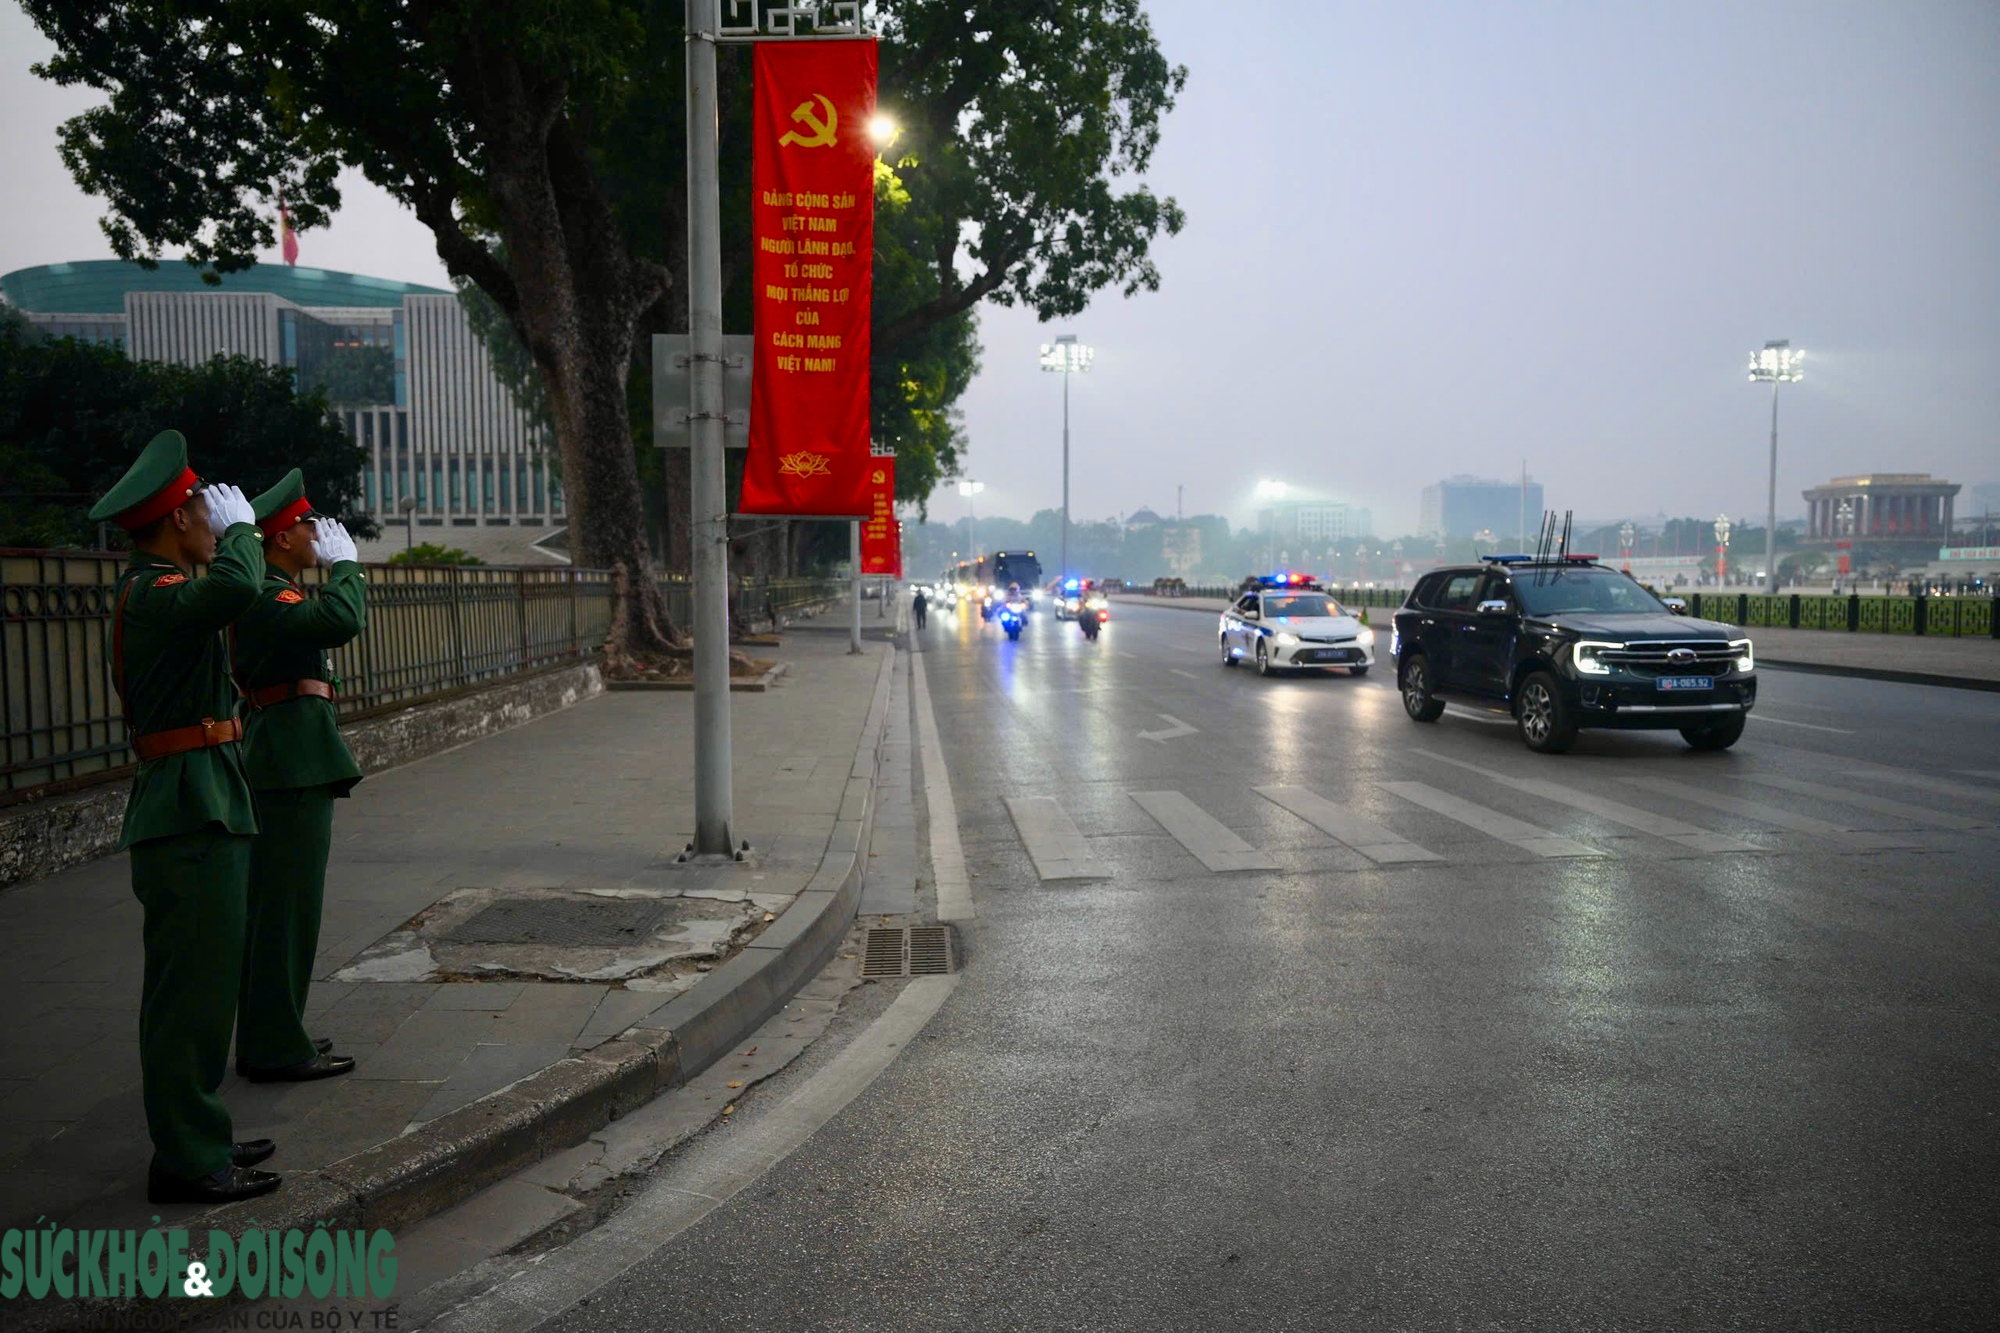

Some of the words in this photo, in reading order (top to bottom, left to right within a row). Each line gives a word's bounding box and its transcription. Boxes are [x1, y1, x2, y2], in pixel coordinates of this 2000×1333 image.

[763, 188, 793, 206] ĐẢNG
[796, 190, 829, 210] CỘNG
[832, 190, 855, 209] SẢN
[782, 214, 805, 233] VIỆT
[808, 217, 837, 232] NAM
[761, 236, 795, 255] NGƯỜI
[798, 238, 829, 255] LÃNH
[801, 262, 833, 279] CHỨC
[766, 284, 788, 304] MỌI
[791, 283, 830, 303] THẮNG
[796, 307, 820, 326] CỦA
[773, 331, 804, 348] CÁCH
[807, 335, 841, 352] MẠNG
[777, 354, 801, 374] VIỆT
